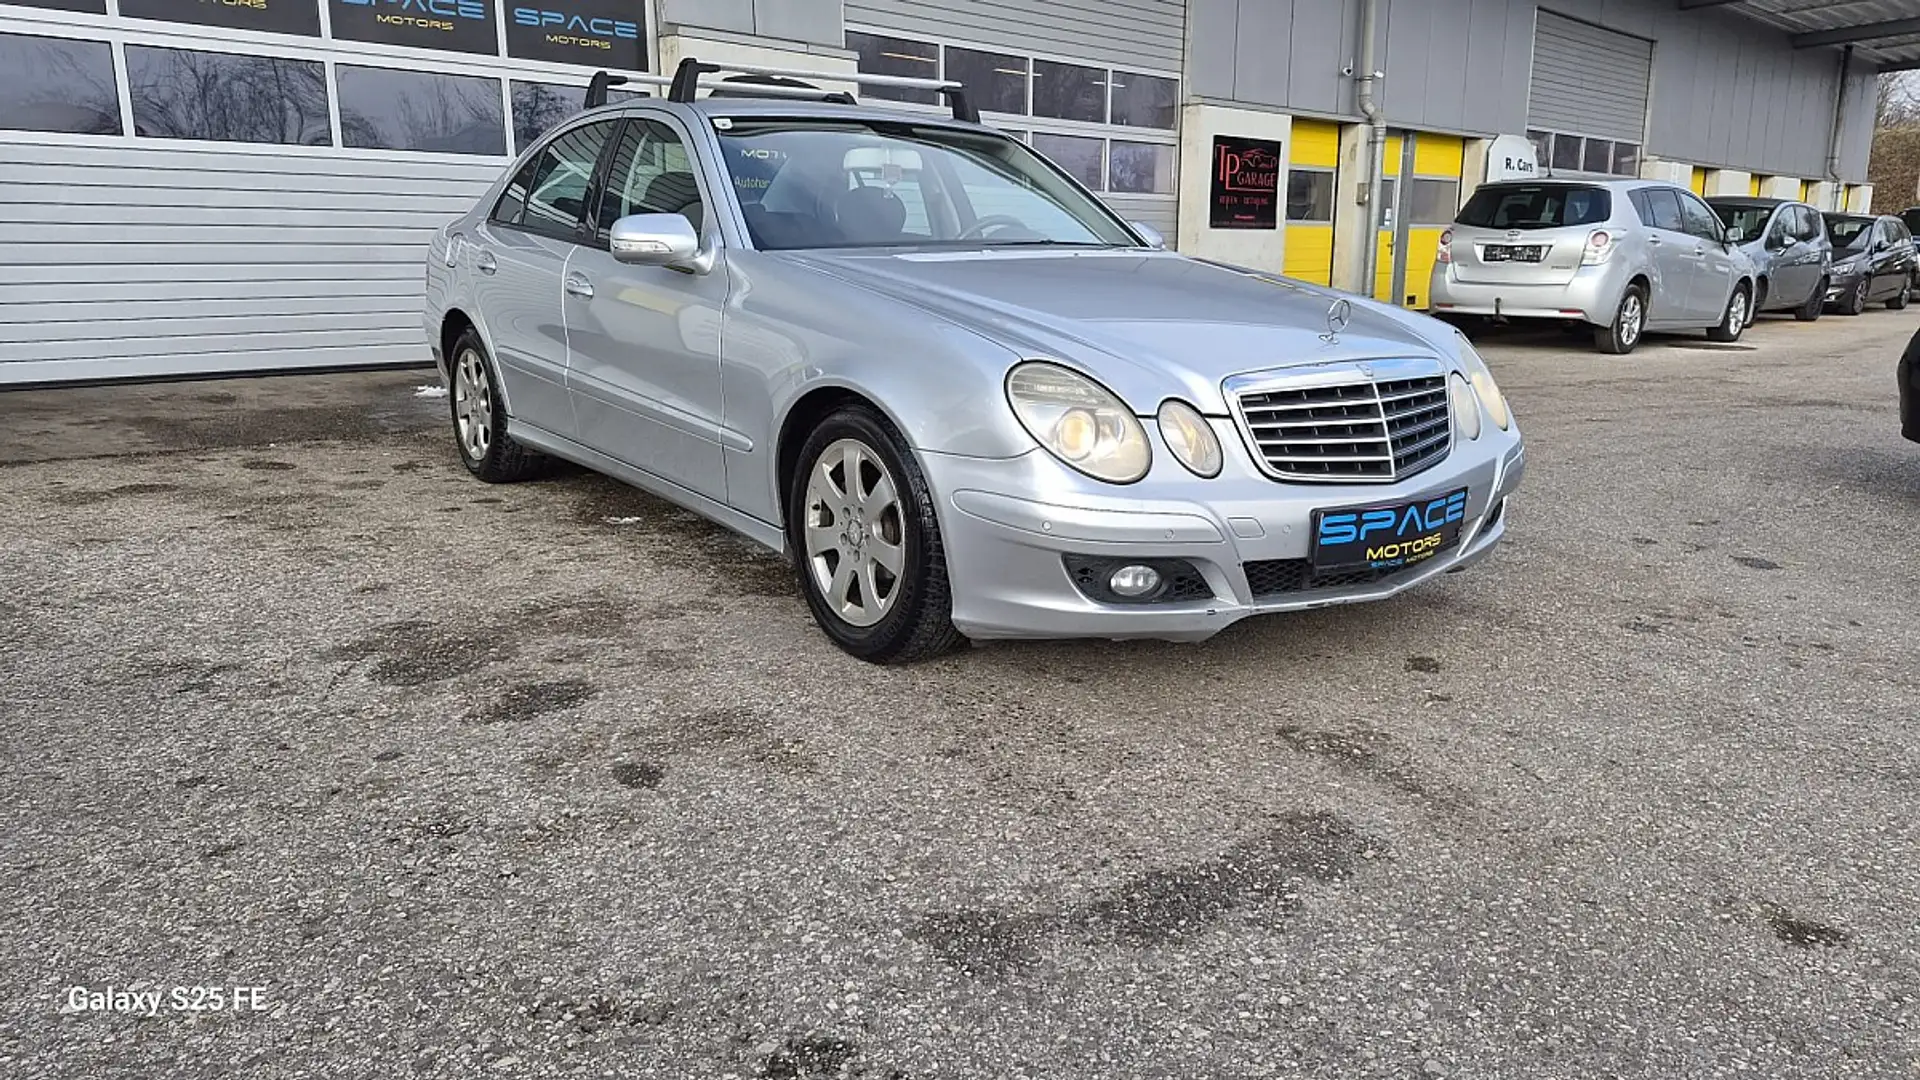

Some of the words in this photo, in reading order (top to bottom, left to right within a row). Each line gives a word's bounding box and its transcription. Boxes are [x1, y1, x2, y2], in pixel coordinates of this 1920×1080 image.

[341, 0, 485, 19] ACE
[376, 14, 455, 31] MOTORS
[513, 8, 638, 38] SPACE
[545, 34, 611, 49] MOTORS
[1505, 157, 1515, 171] R.
[1517, 158, 1533, 173] Cars
[1237, 171, 1277, 188] GARAGE
[1320, 491, 1465, 545] SPACE
[1366, 532, 1442, 561] MOTORS
[1370, 558, 1404, 568] SPACE
[1405, 549, 1434, 564] MOTORS
